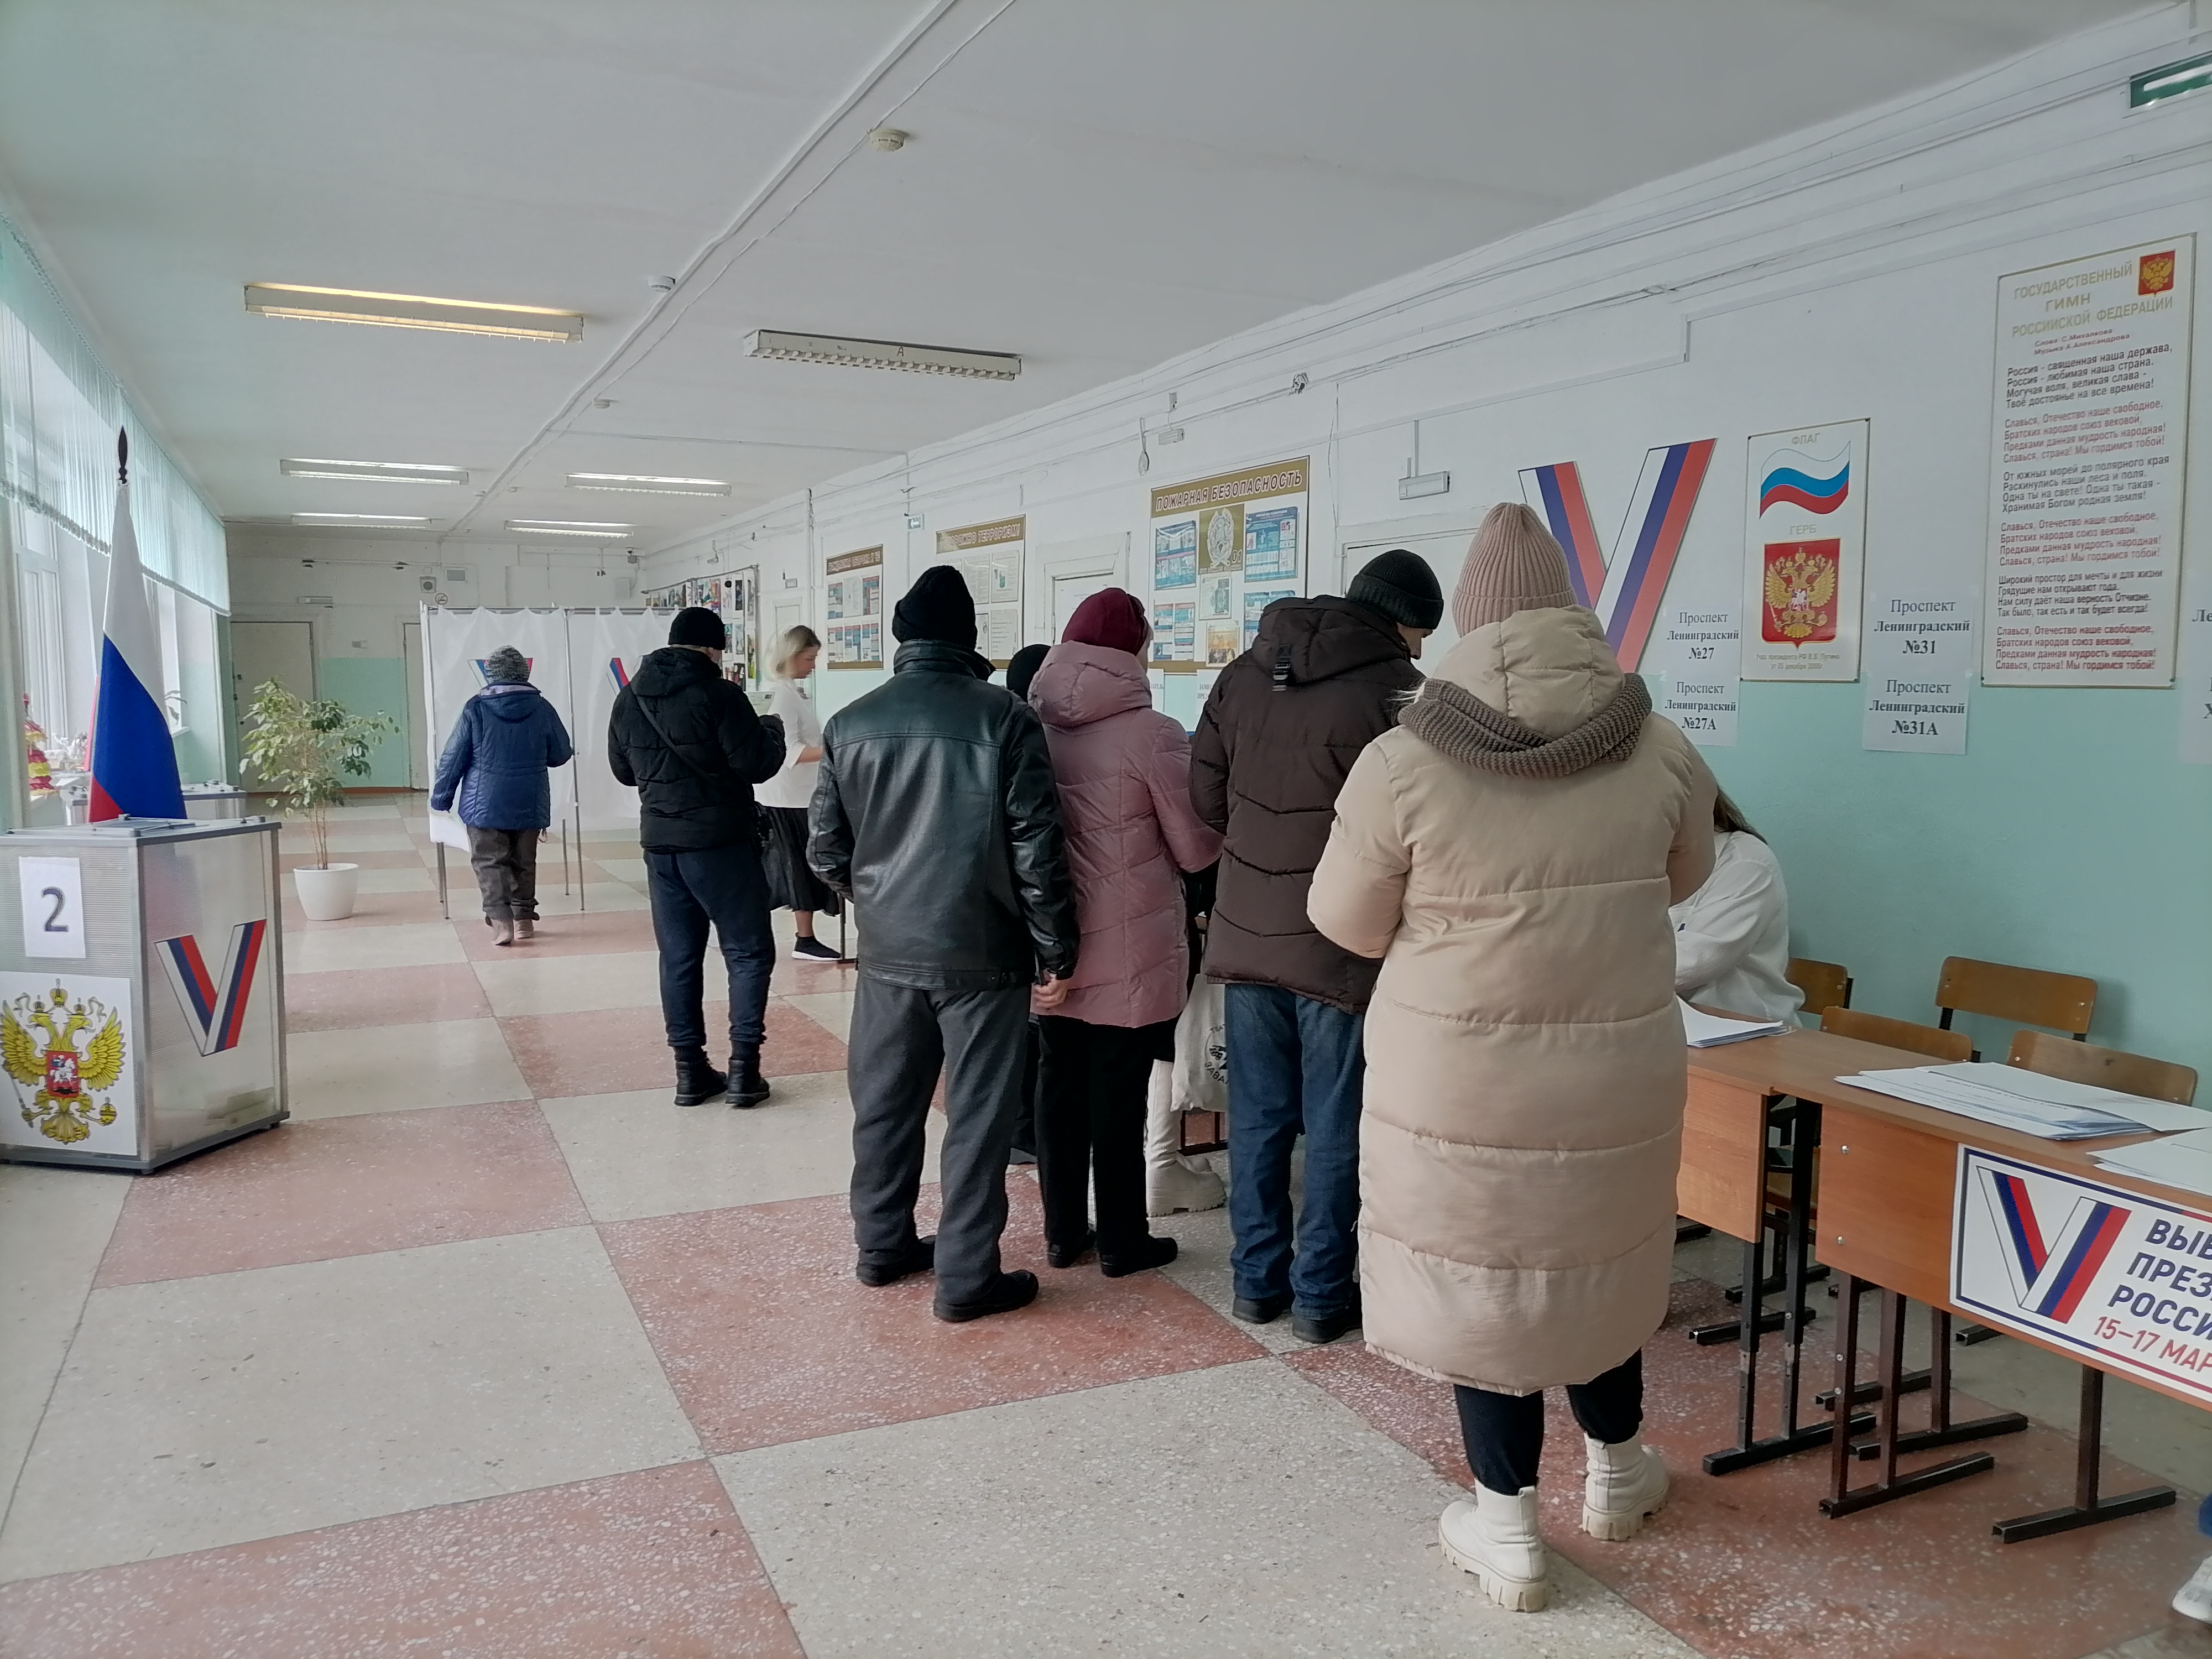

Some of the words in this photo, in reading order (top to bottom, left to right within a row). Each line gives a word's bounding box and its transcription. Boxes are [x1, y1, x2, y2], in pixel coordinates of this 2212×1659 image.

[2014, 260, 2132, 299] ГОСУДАРСТВЕННЫЙ
[2045, 292, 2090, 312] ГИМН
[2096, 295, 2172, 321] ФЕДЕРАЦИИ
[2007, 366, 2038, 377] Россия
[2047, 356, 2097, 371] священная
[2100, 351, 2124, 362] наша
[2007, 376, 2038, 387] Россия
[2090, 364, 2115, 374] наша
[2118, 358, 2153, 371] страна.
[2006, 386, 2042, 398] Могучая
[2072, 376, 2109, 388] великая
[2111, 371, 2139, 383] слава
[2005, 399, 2026, 409] Твоё
[2028, 392, 2074, 407] достоянье
[2077, 390, 2088, 398] на
[2090, 387, 2107, 397] все
[2042, 410, 2085, 423] Отечество
[2088, 407, 2110, 416] наше
[2004, 429, 2041, 441] Братских
[2043, 424, 2078, 436] народов
[2080, 420, 2102, 430] союз
[1792, 433, 1820, 445] ФЛАГ
[2004, 440, 2044, 452] Предками
[2046, 436, 2075, 447] данная
[2078, 431, 2118, 444] мудрость
[2075, 445, 2088, 454] Мы
[2091, 441, 2132, 453] гордимся
[2003, 471, 2014, 481] От
[2016, 470, 2047, 479] южных
[2049, 463, 2078, 476] морей
[2080, 464, 2092, 473] до
[2095, 458, 2144, 471] полярного
[2147, 456, 2169, 466] края
[2003, 479, 2058, 491] Раскинулись
[2061, 476, 2085, 485] наши
[2121, 469, 2146, 479] поля.
[1156, 488, 1208, 511] ПОЖАРНАЯ
[1211, 470, 1302, 502] БЕЗОПАСНОСТЬ
[2002, 493, 2024, 503] Одна
[2085, 484, 2109, 494] Одна
[2127, 480, 2153, 489] такая
[2002, 502, 2045, 514] Хранимая
[2047, 498, 2075, 508] Богом
[2078, 495, 2111, 507] родная
[1790, 524, 1816, 535] ГЕРБ
[2038, 518, 2081, 529] Отечество
[2084, 517, 2106, 525] наше
[2000, 534, 2037, 545] Братских
[2039, 531, 2073, 541] народов
[2075, 529, 2098, 538] союз
[2000, 545, 2039, 556] Предками
[2042, 543, 2071, 553] данная
[2074, 540, 2114, 551] мудрость
[1232, 549, 1242, 564] 01
[2070, 552, 2084, 561] Мы
[2087, 551, 2128, 562] гордимся
[1999, 575, 2032, 585] Широкий
[2034, 574, 2065, 584] простор
[1998, 586, 2035, 596] Грядущие
[2054, 584, 2096, 593] открывают
[1890, 599, 1956, 615] Проспект
[1997, 597, 2012, 606] Нам
[2015, 598, 2032, 607] силу
[2033, 597, 2052, 606] даёт
[2077, 595, 2112, 605] верность
[1997, 607, 2010, 617] Так
[2091, 604, 2116, 615] будет
[1679, 612, 1728, 625] Проспект
[1874, 620, 1970, 634] Ленинградский
[2034, 625, 2077, 634] Отечество
[1667, 630, 1739, 641] Ленинградский
[1996, 637, 2032, 648] Братских
[2034, 639, 2069, 648] народов
[1688, 647, 1714, 660] №27
[1902, 640, 1936, 654] №31
[1996, 649, 2036, 660] Предками
[2037, 650, 2067, 659] данная
[2069, 650, 2109, 659] мудрость
[2065, 660, 2080, 669] Мы
[2082, 662, 2124, 671] гордимся
[1676, 681, 1725, 696] Проспект
[1886, 679, 1952, 696] Проспект
[1665, 700, 1736, 712] Ленинградский
[1869, 700, 1965, 715] Ленинградский
[1682, 717, 1717, 730] №27А
[1891, 720, 1938, 735] №31А
[41, 888, 69, 933] 2
[1204, 1062, 1228, 1084] ЗАВА
[2127, 1252, 2212, 1301] ПРЕЗ
[2107, 1284, 2212, 1340] РОССИ
